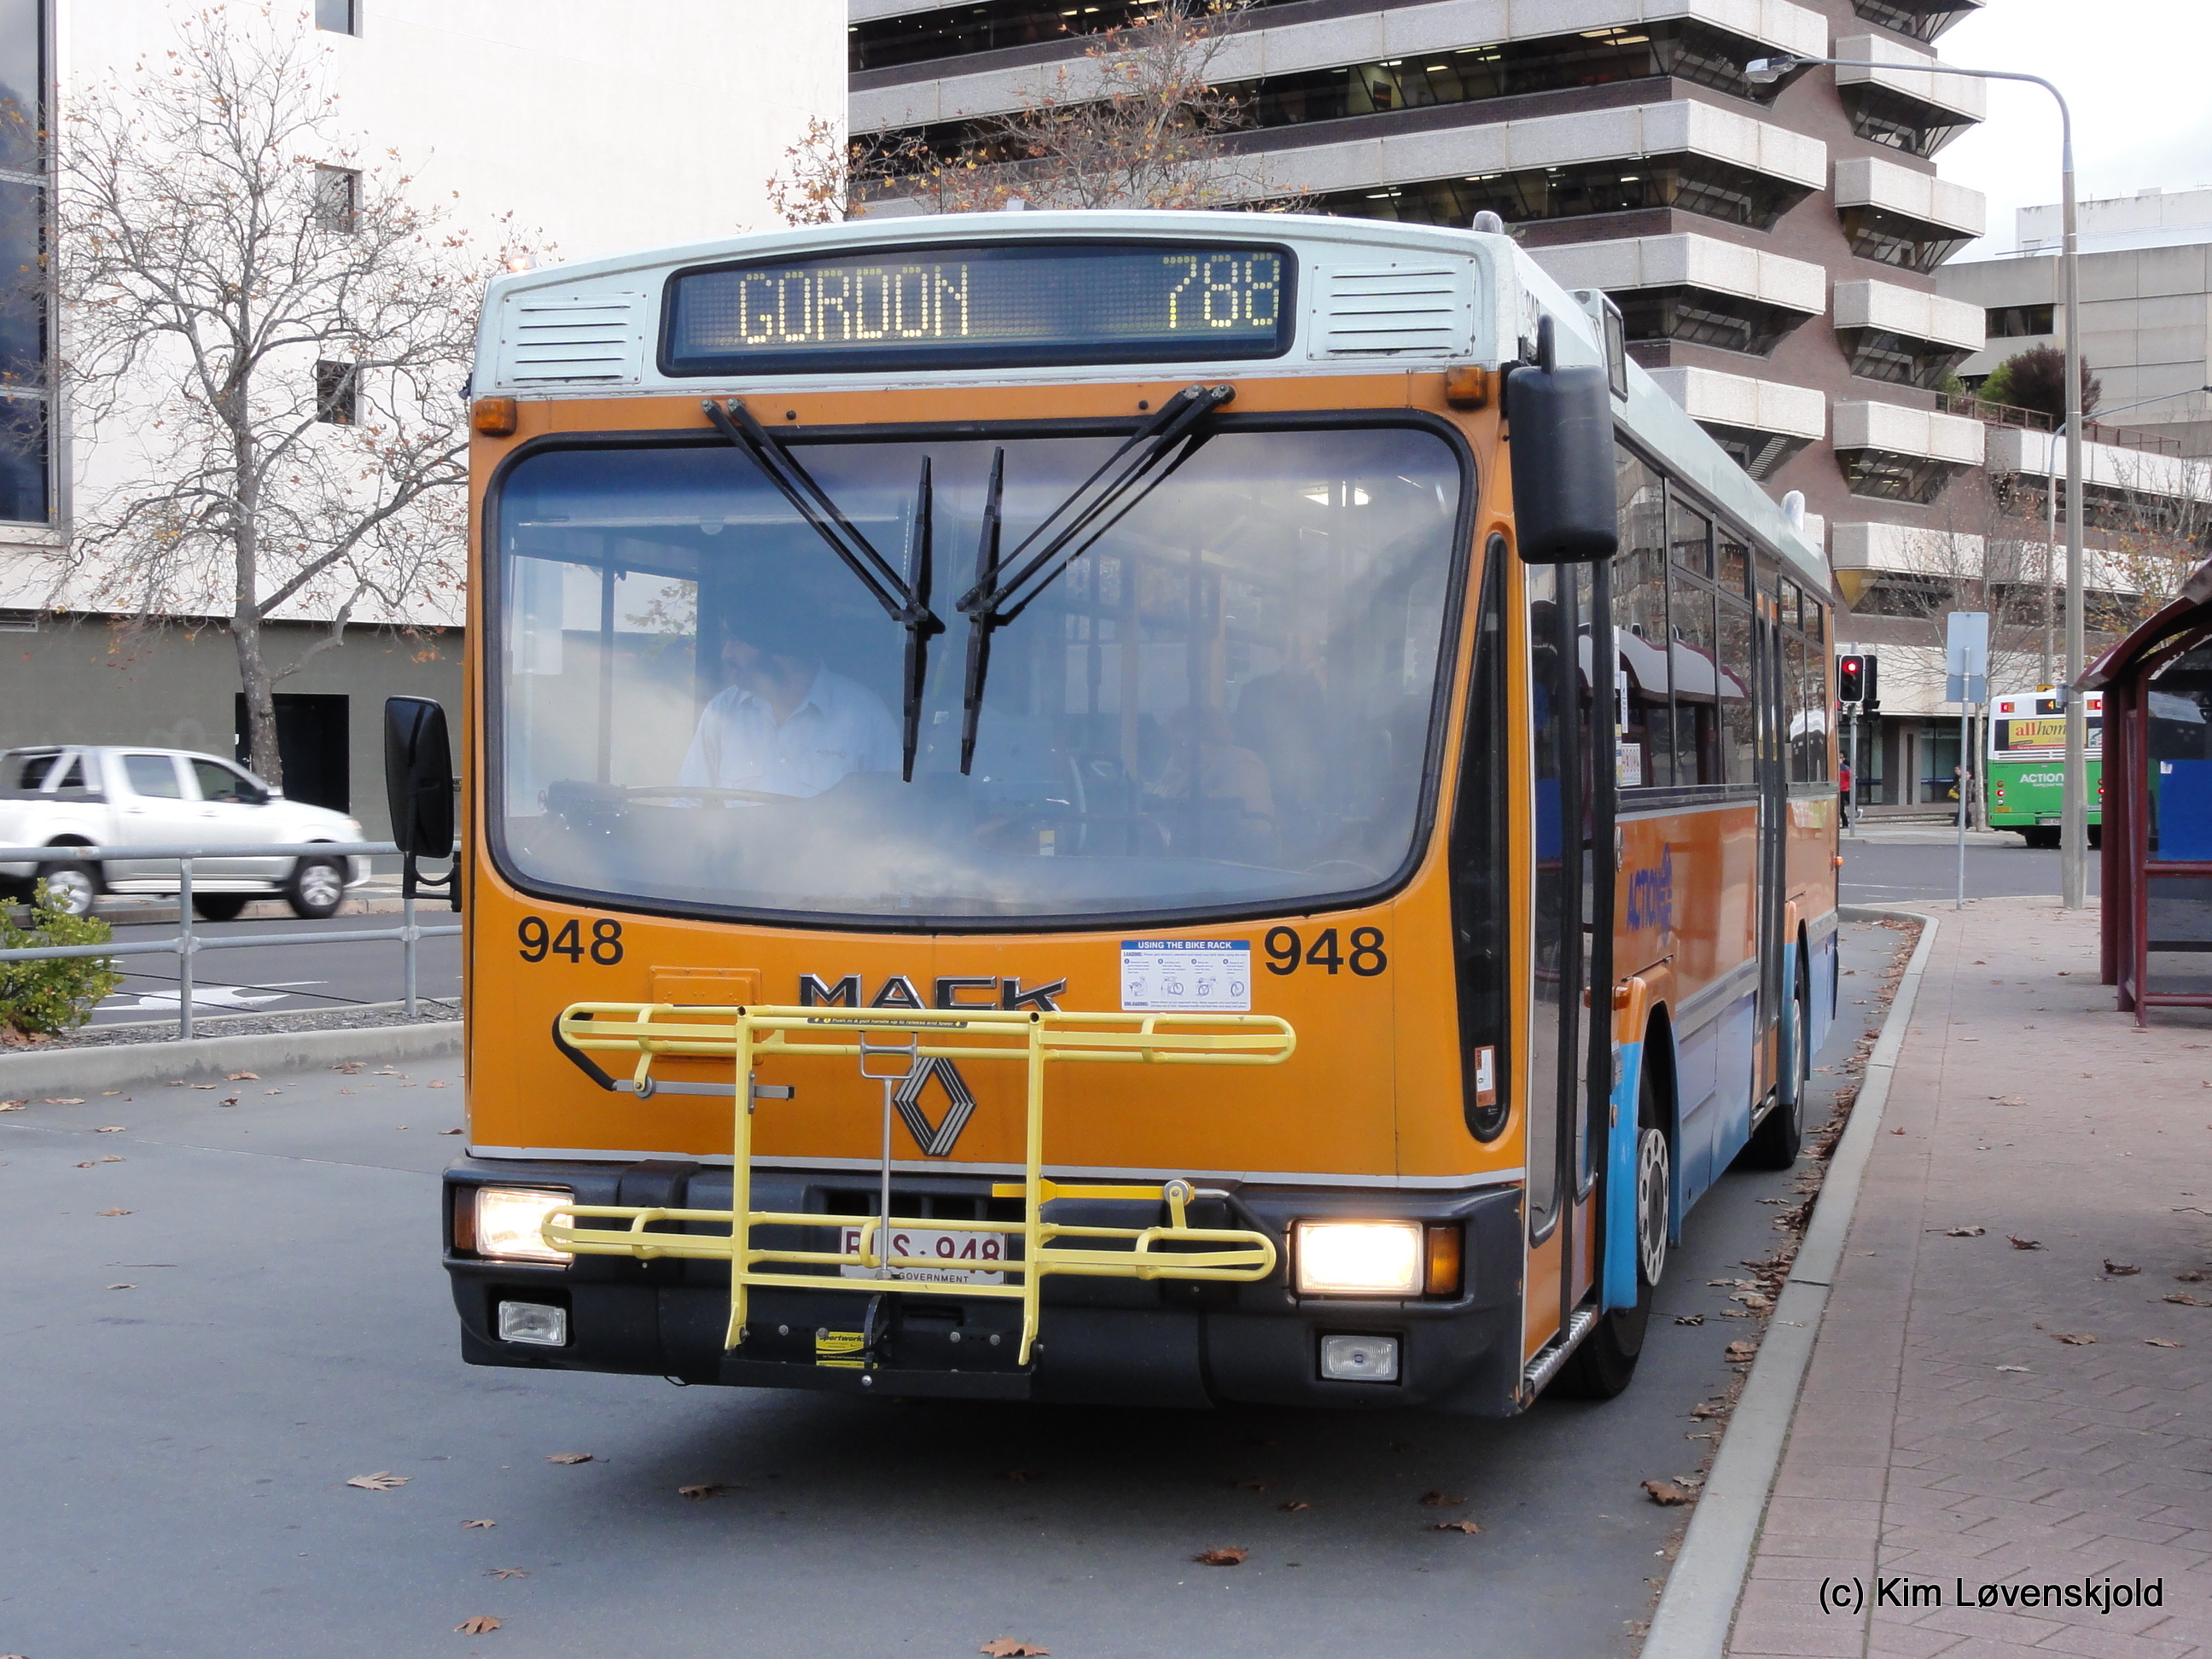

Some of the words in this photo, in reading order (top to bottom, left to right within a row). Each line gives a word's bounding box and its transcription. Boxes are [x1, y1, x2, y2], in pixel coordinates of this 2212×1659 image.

[740, 265, 968, 344] GORDON
[1163, 253, 1280, 329] 788
[2015, 721, 2066, 736] allhom
[2019, 773, 2064, 783] ACTION
[518, 916, 624, 966] 948
[1264, 926, 1388, 977] 948
[799, 973, 1067, 1012] MACK
[899, 1272, 969, 1284] GOVERNMENT
